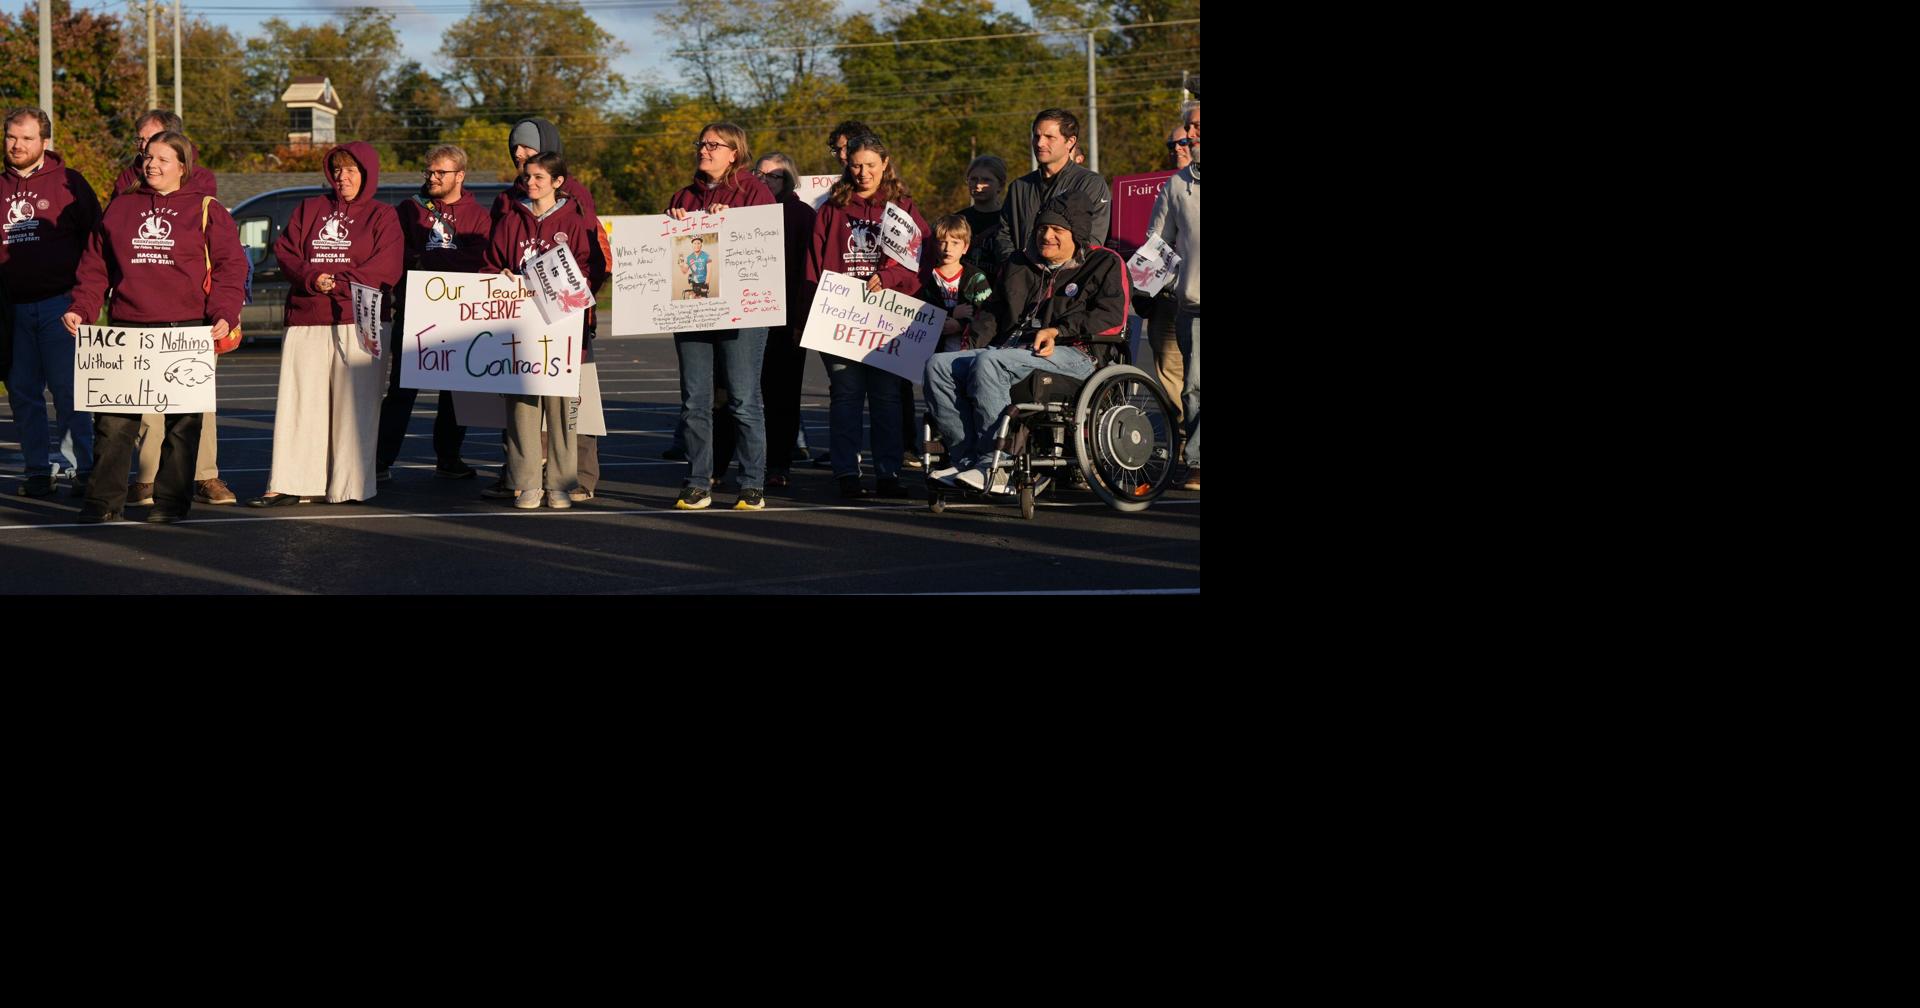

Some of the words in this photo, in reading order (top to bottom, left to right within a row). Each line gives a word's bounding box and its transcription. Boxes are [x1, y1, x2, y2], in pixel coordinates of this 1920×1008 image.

[1127, 184, 1154, 196] Fair
[140, 207, 178, 217] HACCEA
[322, 210, 355, 224] HACCEA
[661, 220, 678, 236] Is
[681, 216, 697, 232] It
[890, 225, 901, 236] is
[730, 231, 752, 241] Ski's
[616, 246, 638, 258] What
[640, 244, 666, 257] Faculty
[556, 248, 581, 291] Enough
[725, 259, 755, 269] Property
[756, 255, 776, 267] Rights
[551, 266, 560, 277] is
[616, 271, 662, 284] Intellectual
[738, 267, 759, 278] Gone
[425, 276, 465, 301] Our
[535, 261, 557, 301] Enough
[617, 283, 646, 295] Property
[647, 278, 666, 289] Rights
[820, 272, 850, 296] Even
[742, 289, 758, 297] Give
[370, 293, 379, 339] Enough
[459, 299, 525, 321] DESERVE
[820, 297, 869, 325] treated
[877, 314, 894, 331] his
[900, 325, 927, 343] staff
[77, 326, 126, 349] HACC
[139, 332, 155, 349] is
[161, 331, 210, 354] Nothing
[415, 324, 457, 372] Fair
[833, 323, 900, 357] BETTER
[77, 353, 124, 370] Without
[133, 354, 151, 370] its
[87, 378, 168, 412] Faculty
